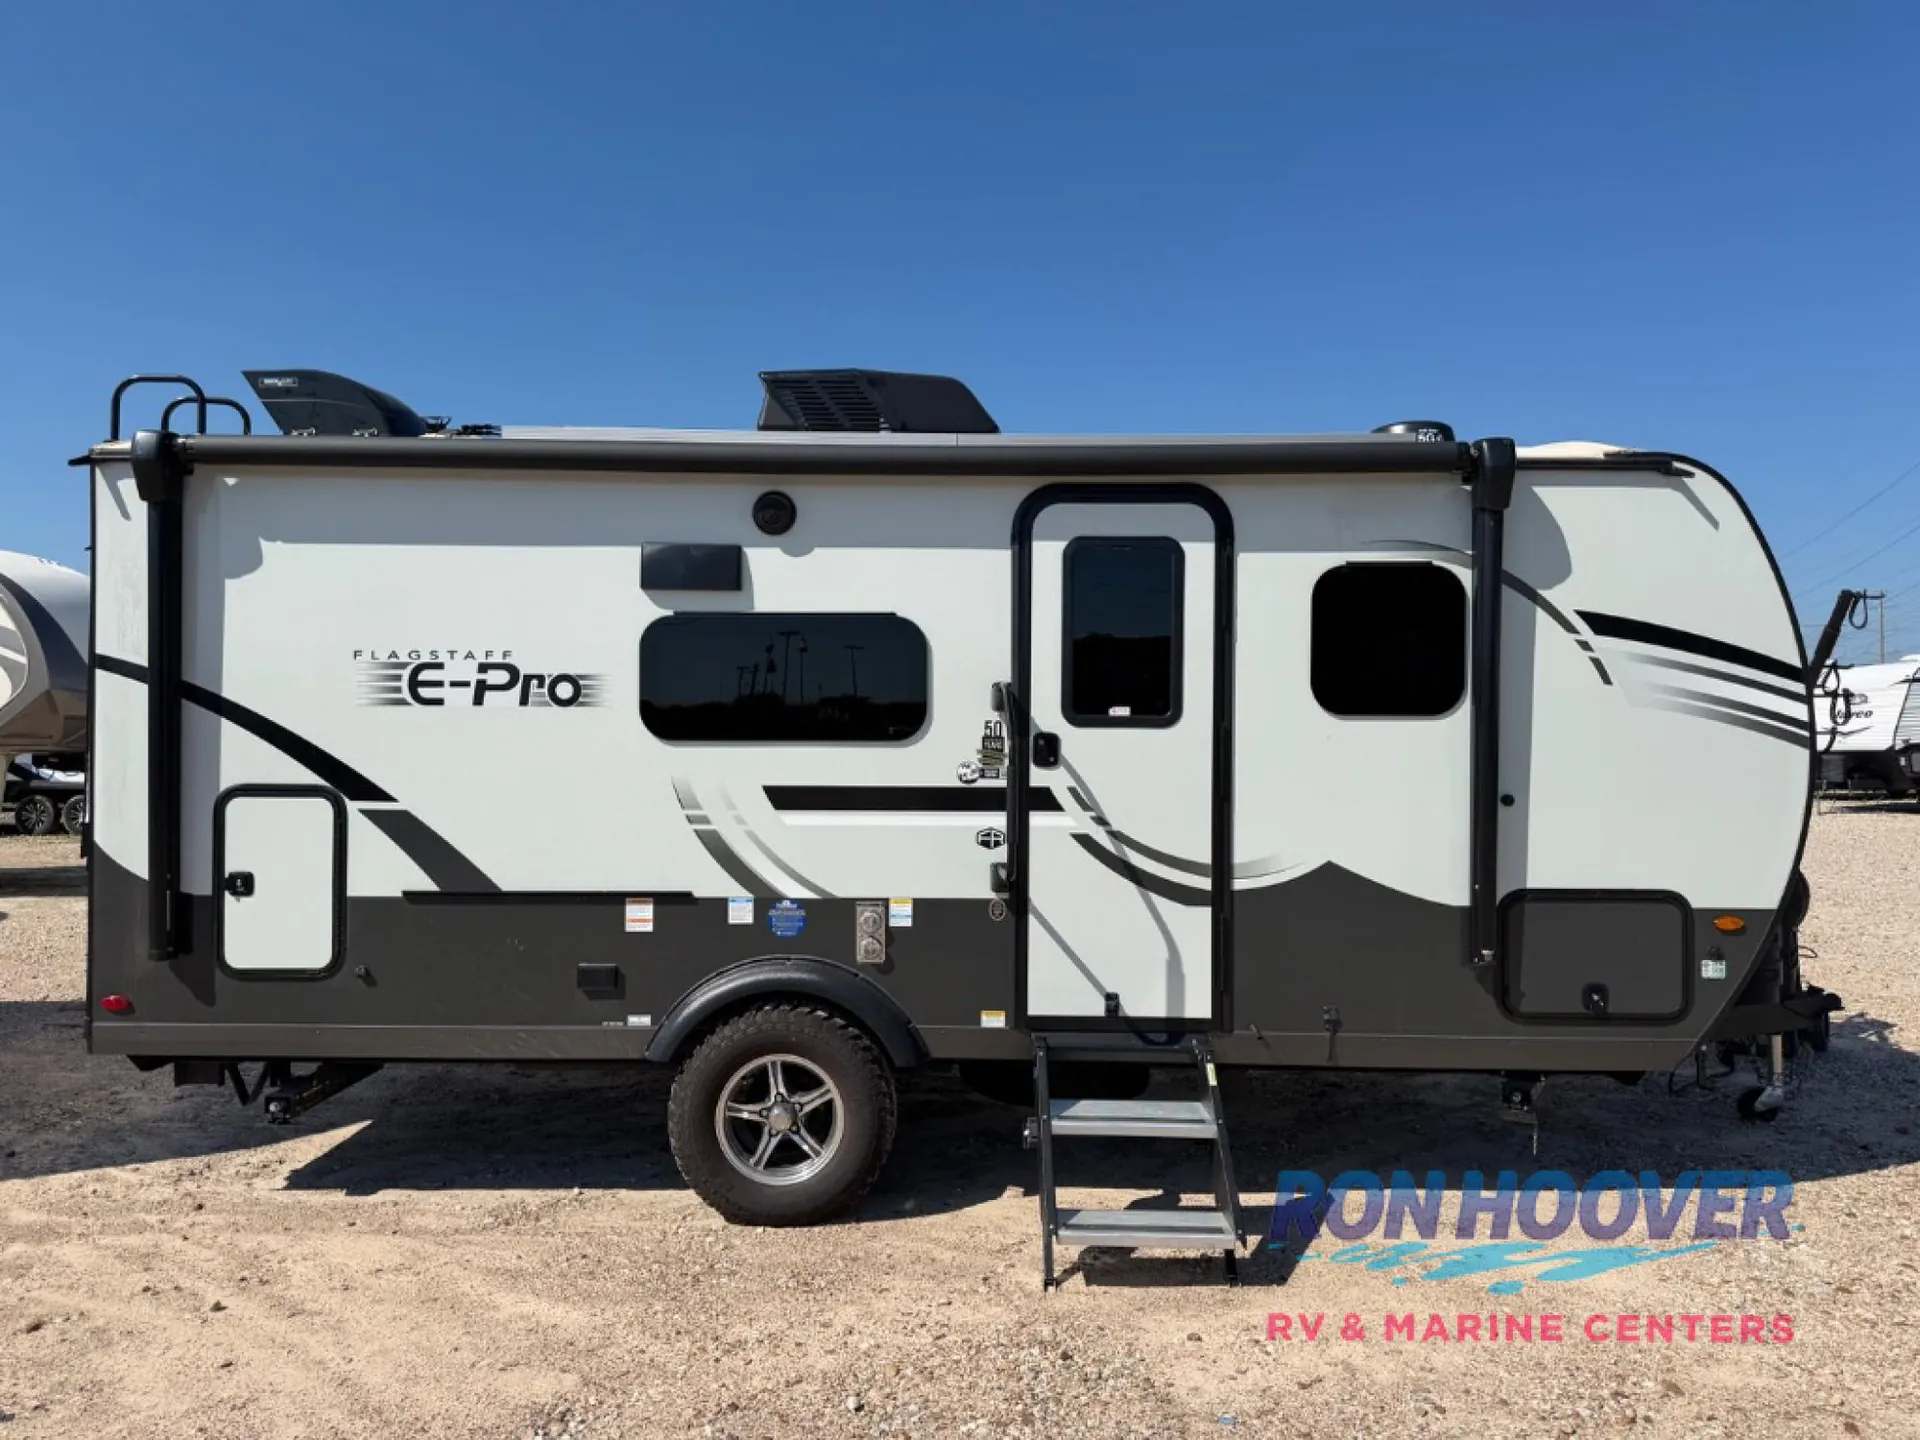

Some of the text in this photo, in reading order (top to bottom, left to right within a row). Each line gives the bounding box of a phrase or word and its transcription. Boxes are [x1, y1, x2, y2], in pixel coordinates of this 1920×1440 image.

[353, 650, 513, 661] FLAGSTAFF
[408, 661, 582, 707] E-Pro
[984, 720, 1002, 737] 50
